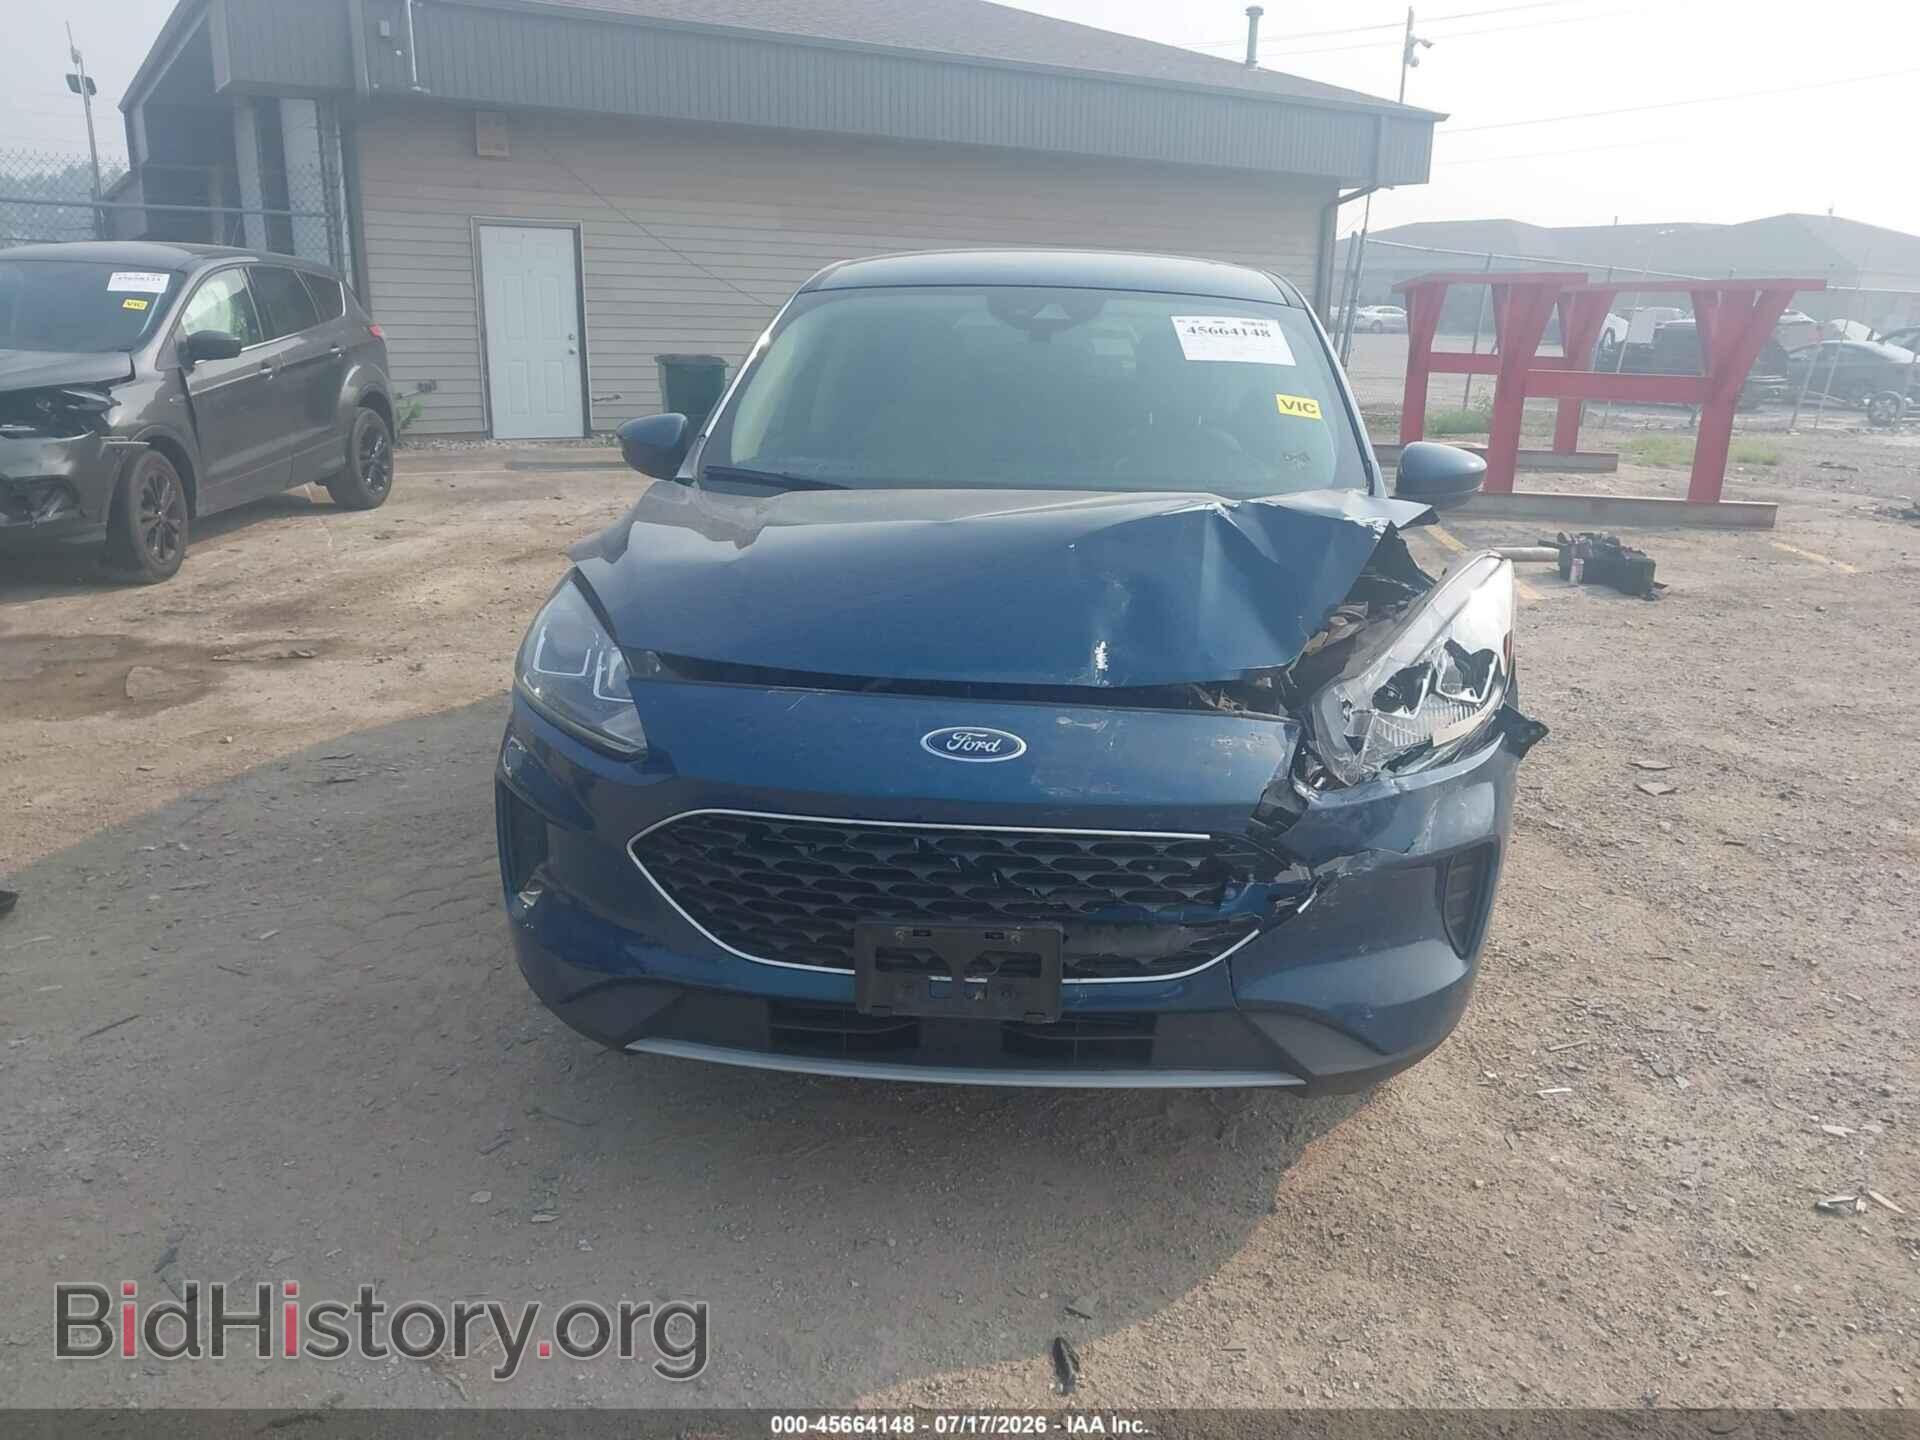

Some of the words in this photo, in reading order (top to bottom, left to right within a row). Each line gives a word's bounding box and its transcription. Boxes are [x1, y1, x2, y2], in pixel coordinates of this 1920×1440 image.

[1186, 326, 1272, 337] 45664148
[1280, 399, 1317, 414] VIC
[946, 731, 1002, 752] Ford
